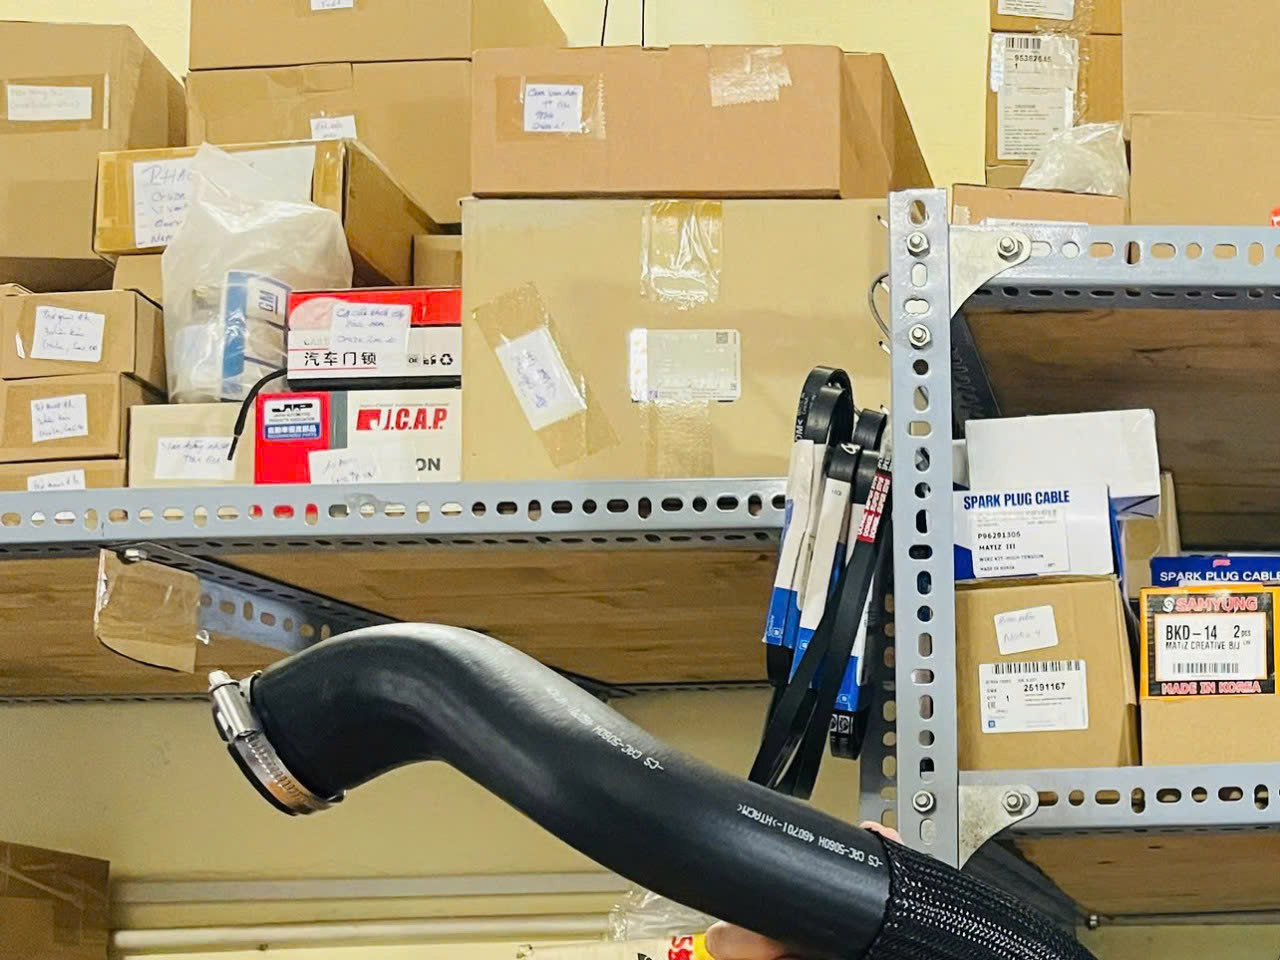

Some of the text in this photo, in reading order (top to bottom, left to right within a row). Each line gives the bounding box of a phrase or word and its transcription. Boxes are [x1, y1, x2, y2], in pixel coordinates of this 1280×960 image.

[304, 352, 377, 367] 汽车门锁
[963, 490, 1070, 510] SPARK PLUG CABLE
[1160, 571, 1202, 581] SPARK
[1205, 571, 1239, 581] PLUG
[1175, 596, 1258, 613] SAMYUNG
[1233, 625, 1240, 638] 2
[1165, 641, 1188, 650] MATIZ
[1191, 641, 1226, 650] CREATIVE
[1023, 682, 1066, 692] 25191167
[1161, 681, 1262, 695] MADE IN KOREA
